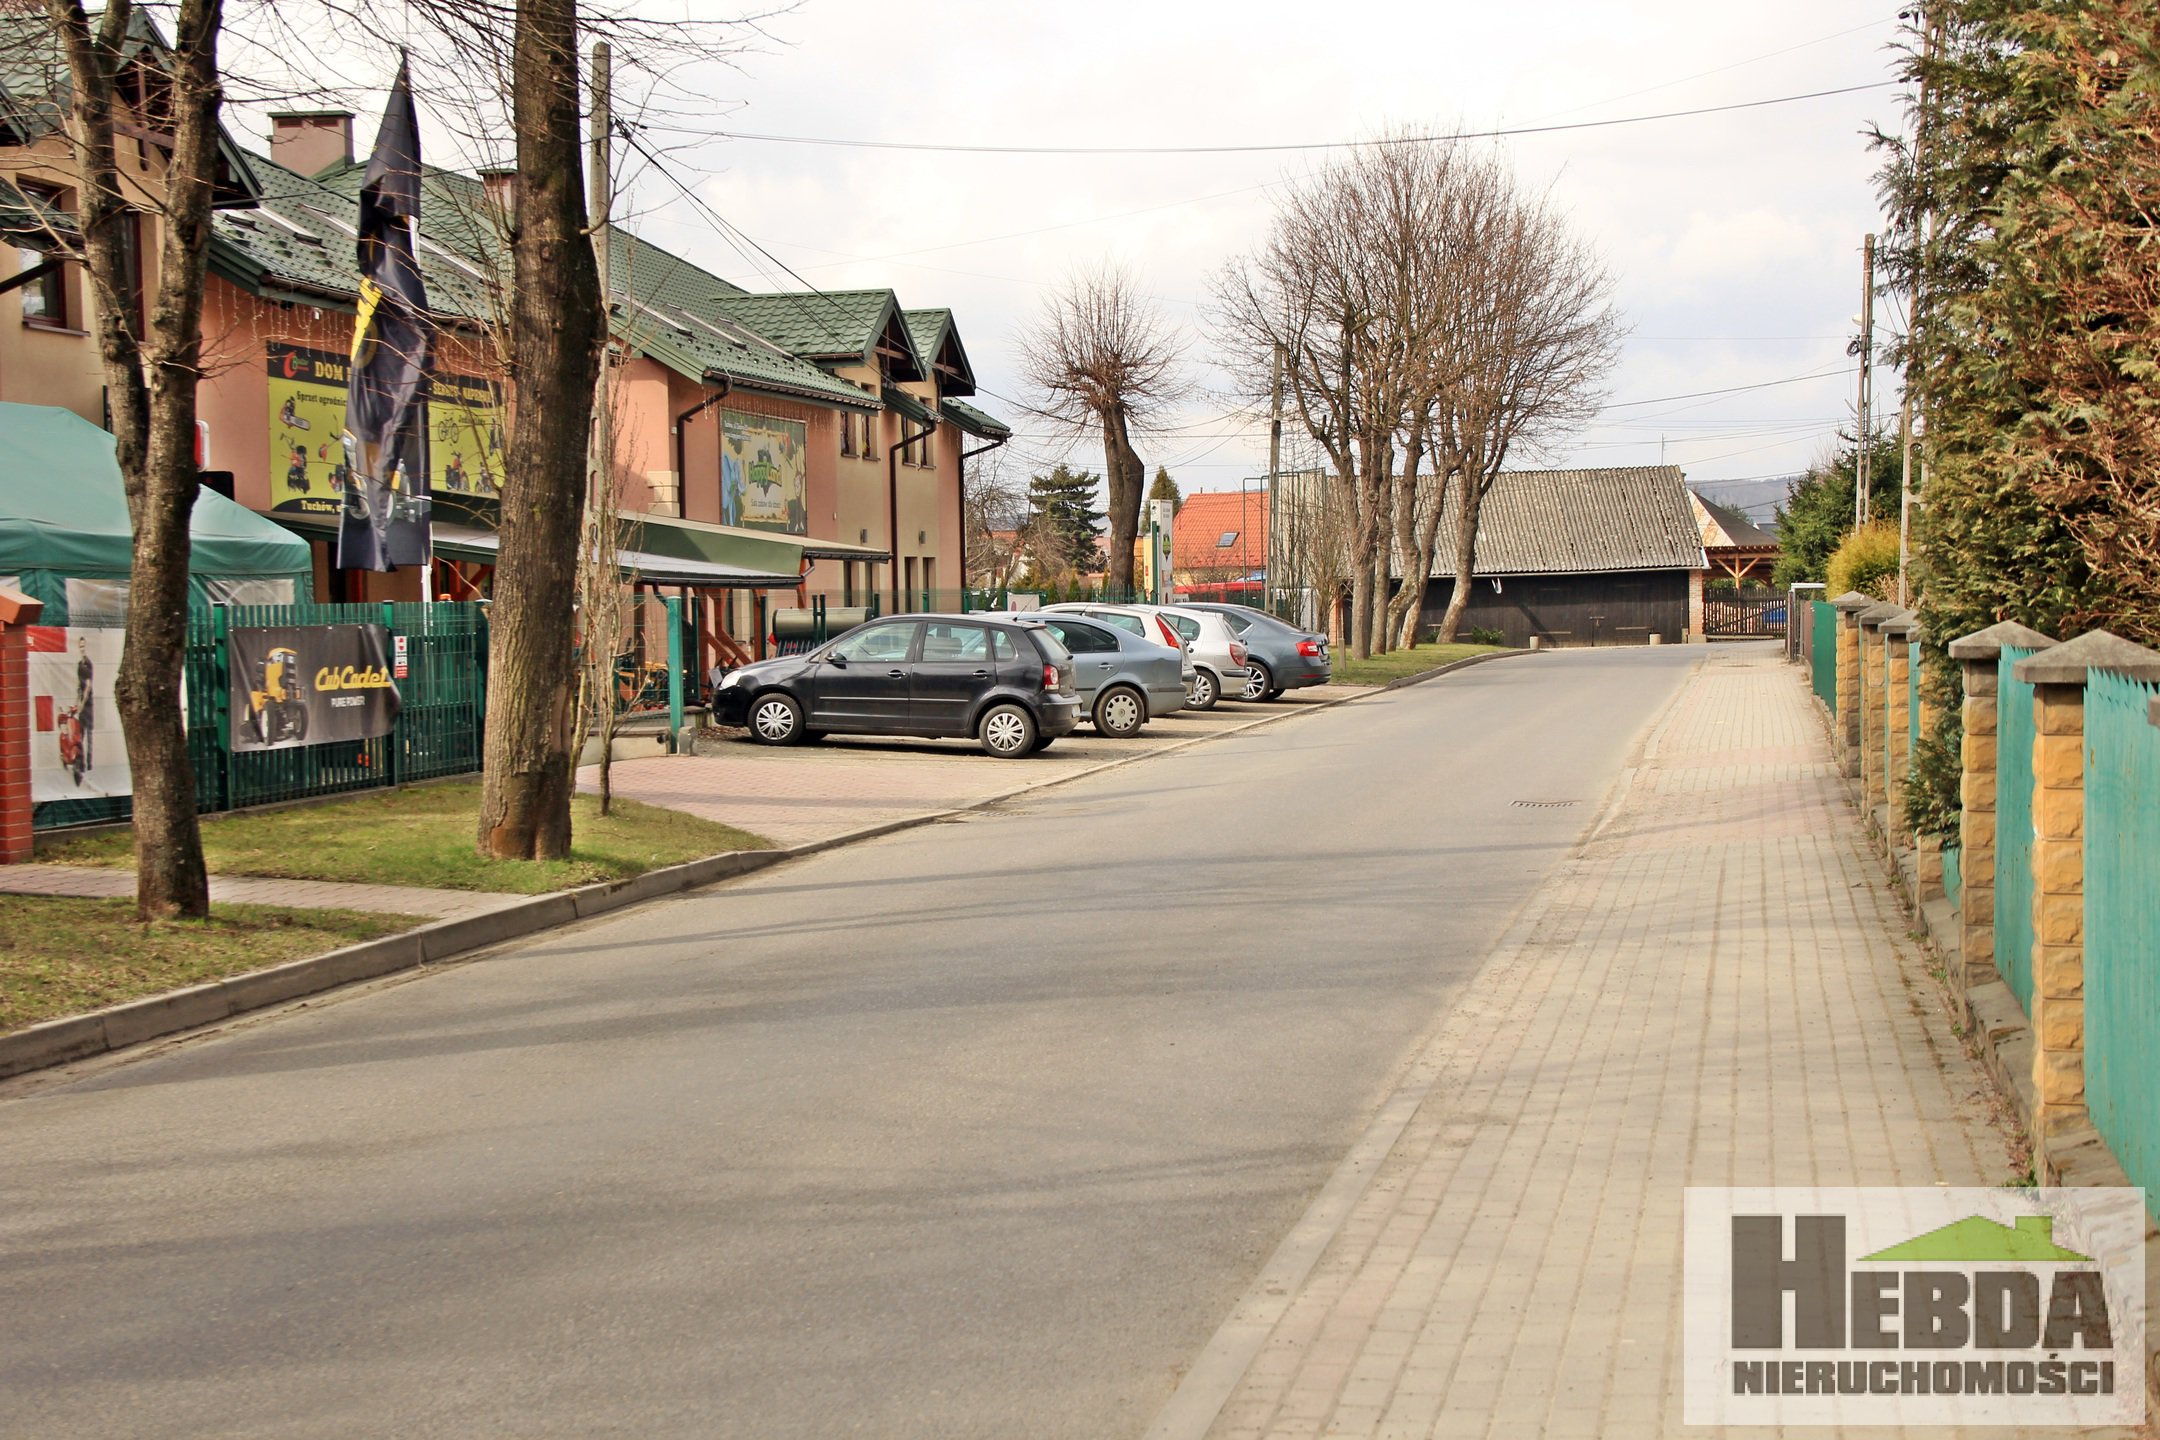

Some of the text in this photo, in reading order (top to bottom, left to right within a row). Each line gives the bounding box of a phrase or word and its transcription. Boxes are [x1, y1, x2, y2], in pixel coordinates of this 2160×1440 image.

[315, 361, 344, 381] DOM
[319, 396, 347, 407] ogrodnic
[331, 695, 365, 708] PURE POWER
